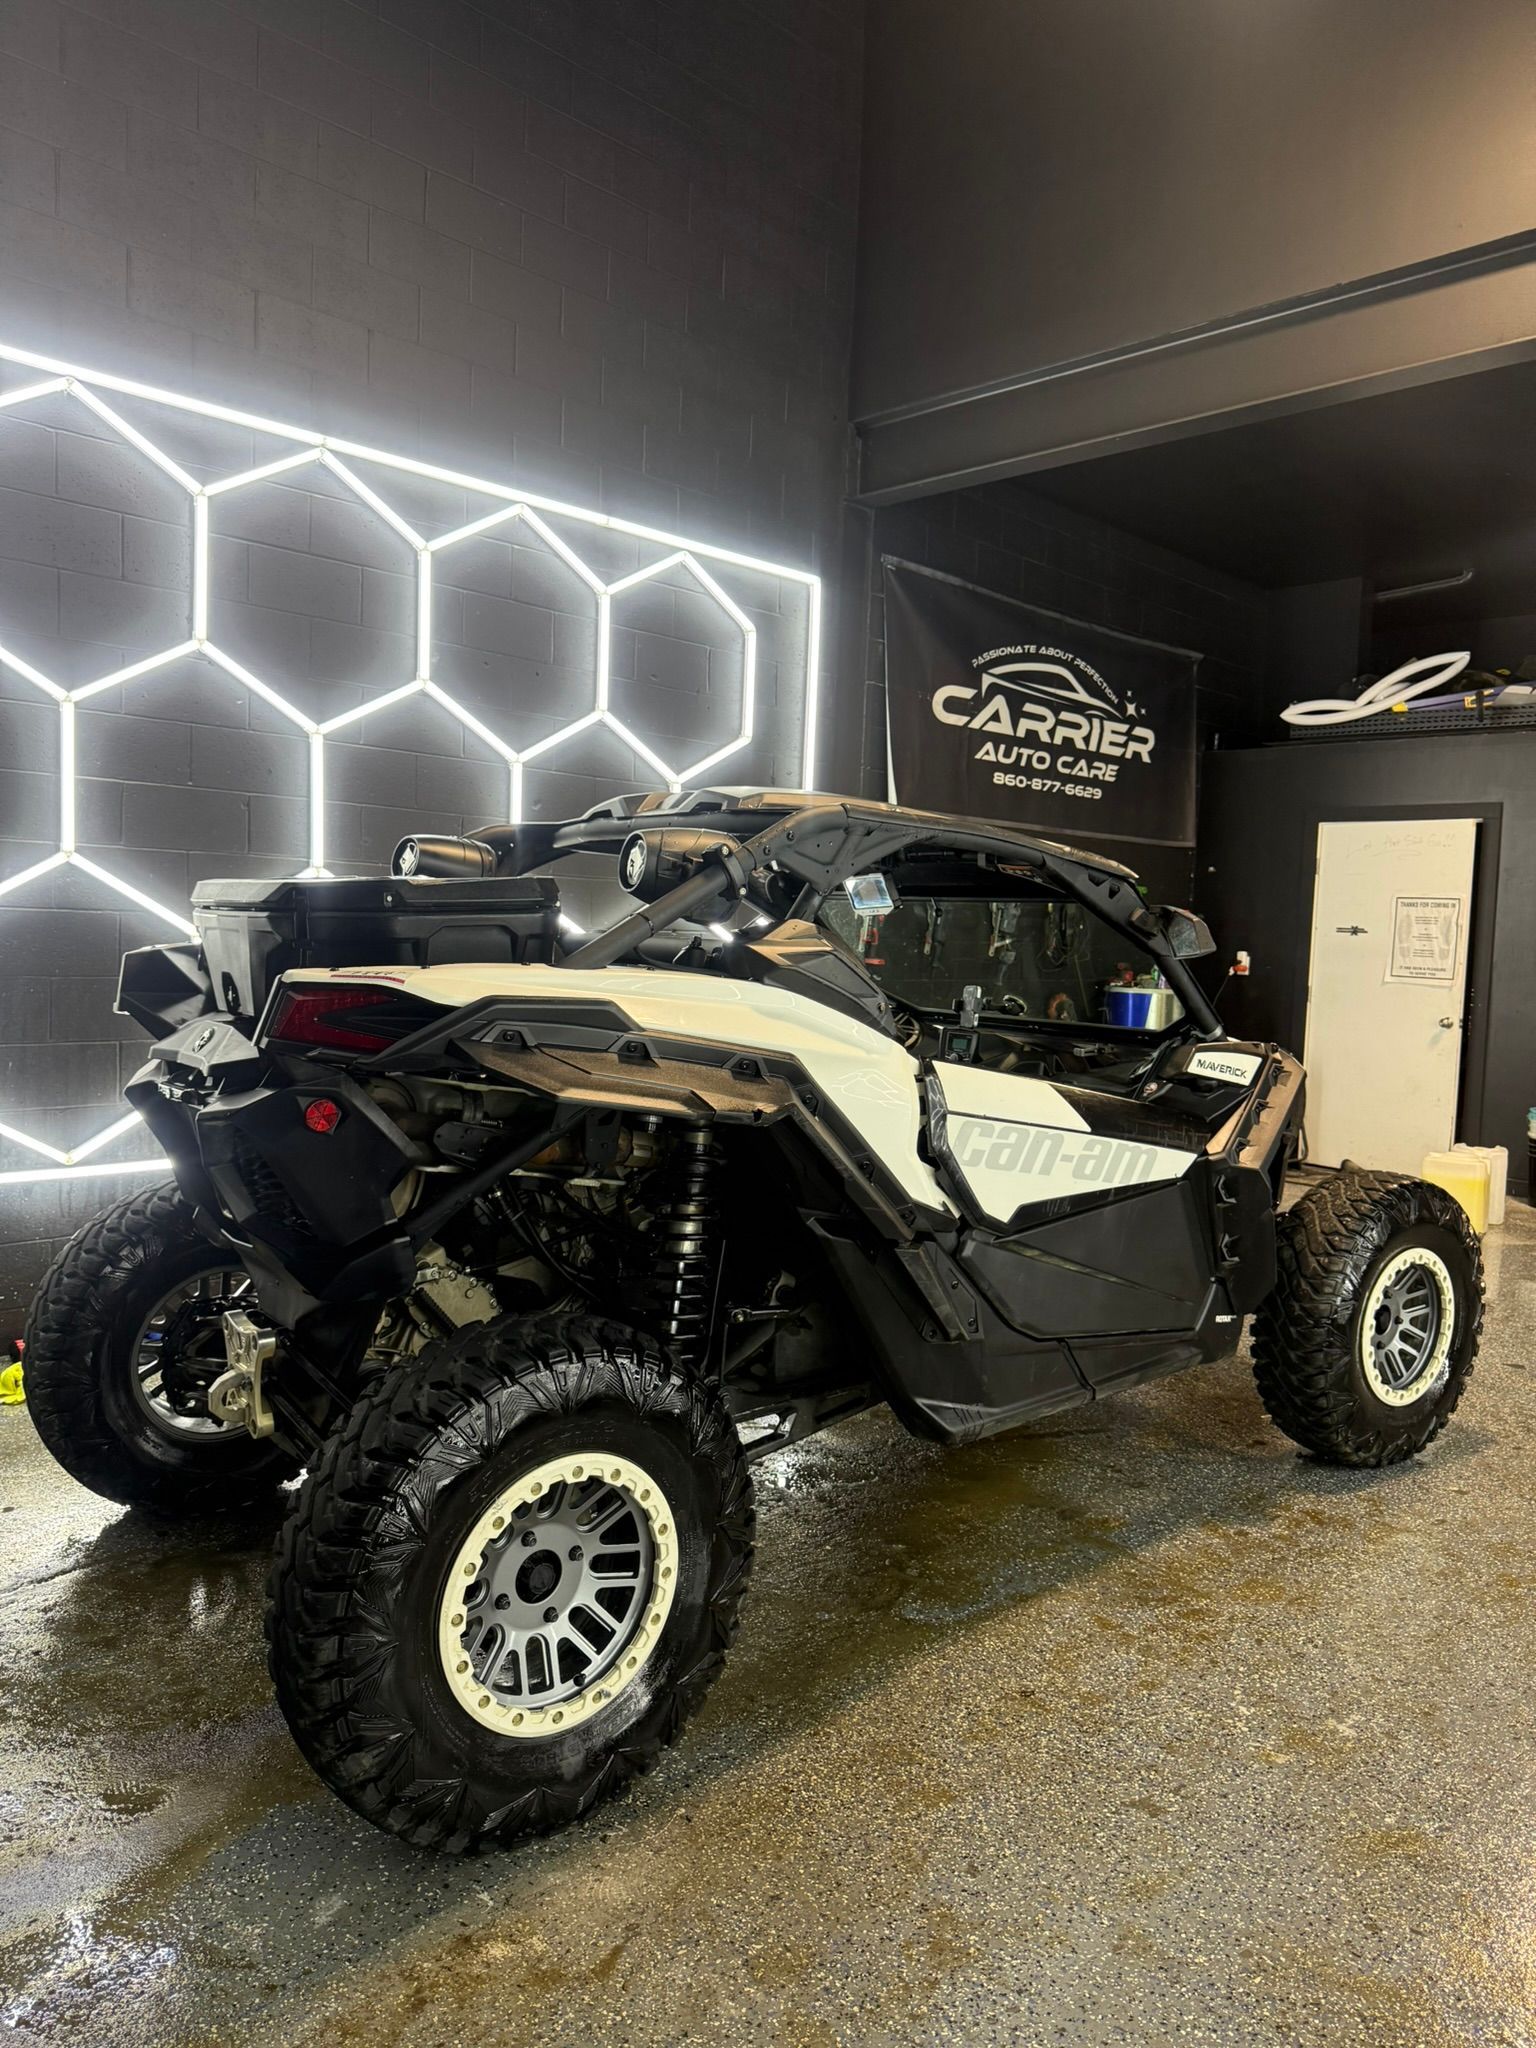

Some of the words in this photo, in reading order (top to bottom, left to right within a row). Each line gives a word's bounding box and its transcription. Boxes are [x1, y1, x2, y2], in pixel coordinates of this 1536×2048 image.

[971, 645, 1037, 668] PASSIONATE
[1038, 646, 1074, 662] ABOUT
[1073, 658, 1119, 704] PERFECTION
[931, 685, 1156, 763] CARRIER
[974, 741, 1051, 770] AUTO
[1056, 755, 1120, 782] CARE
[992, 772, 1103, 800] 860-877-6629
[1196, 1059, 1247, 1079] MAVERICK
[953, 1120, 1158, 1184] can-am
